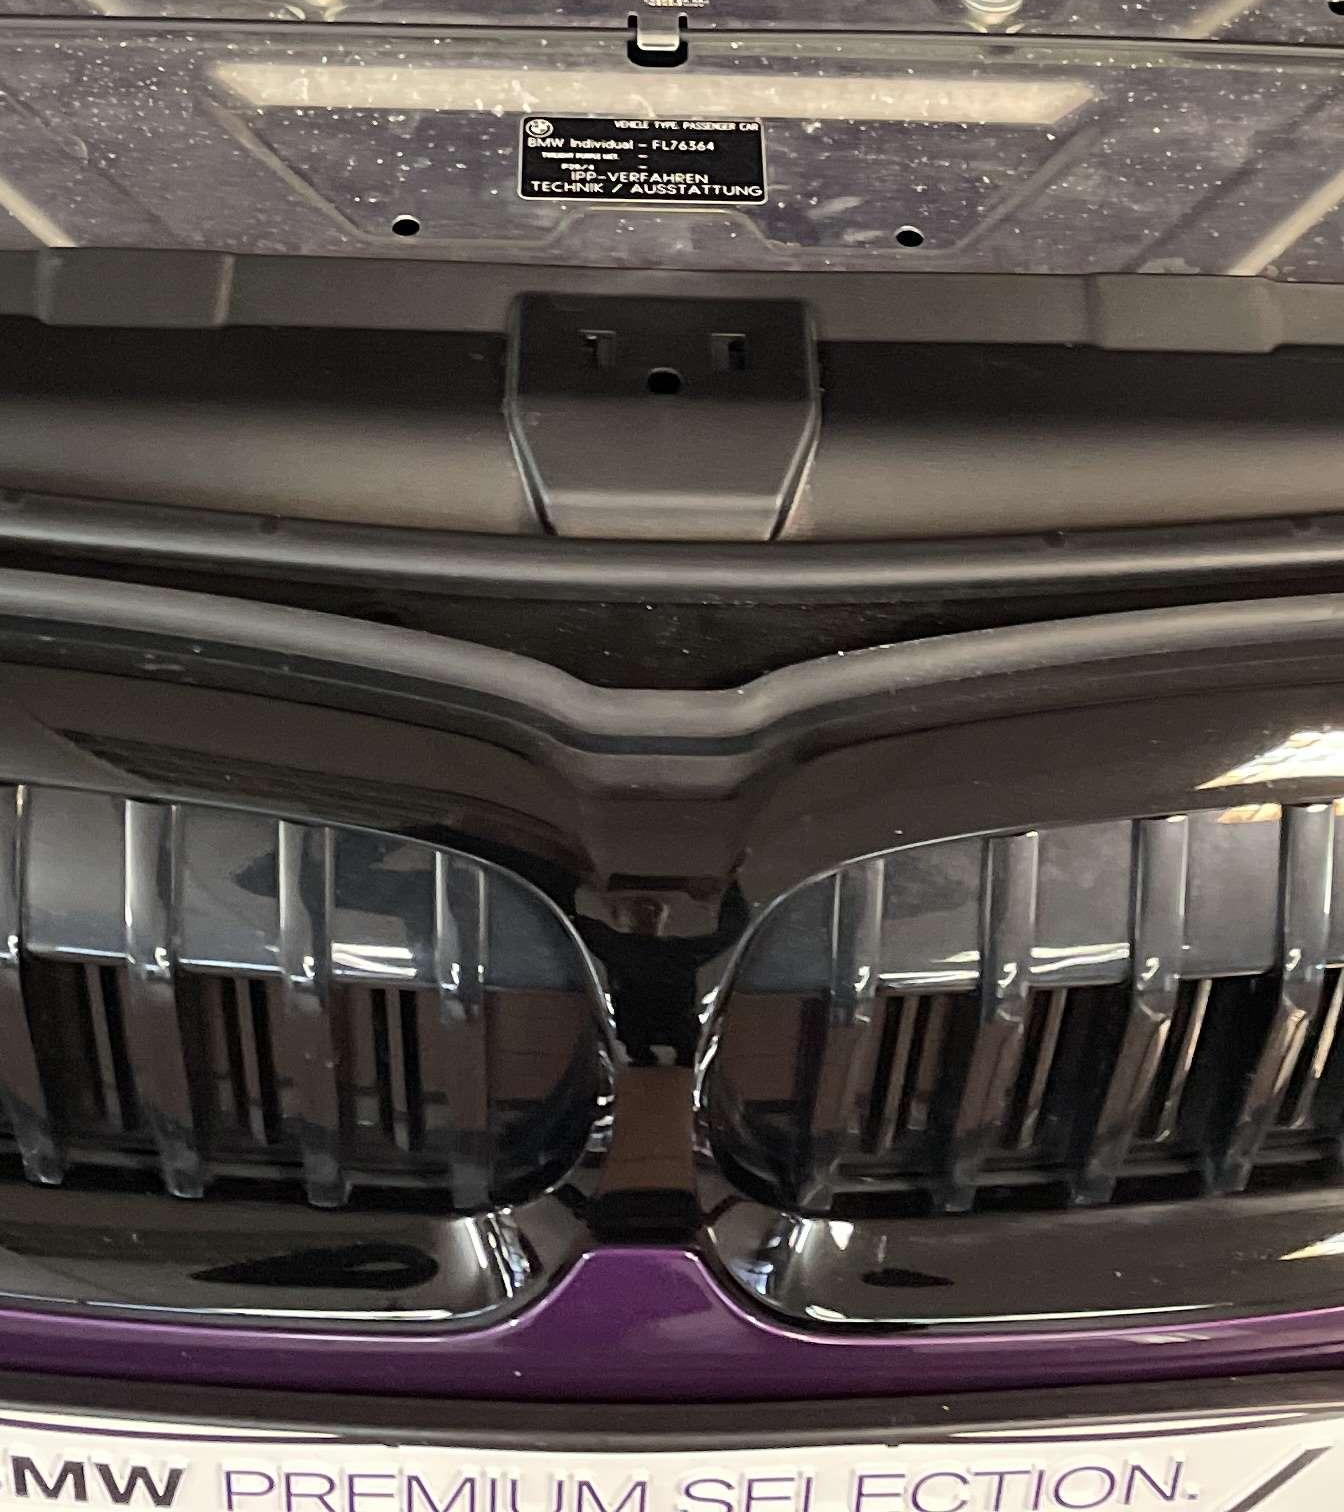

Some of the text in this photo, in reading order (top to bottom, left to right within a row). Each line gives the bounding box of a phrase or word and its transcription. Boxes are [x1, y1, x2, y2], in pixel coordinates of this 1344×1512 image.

[614, 120, 649, 129] VEHICLE
[682, 121, 736, 131] PASSENGER
[739, 123, 759, 131] CAR
[527, 136, 564, 148] BMW
[570, 138, 634, 150] Individual
[652, 139, 715, 151] FL76364
[571, 171, 709, 184] IPP-VERFAHREN
[530, 180, 604, 193] TECHNIK
[629, 183, 763, 197] AUSSTATTUNG
[224, 1470, 647, 1512] PREMIUM
